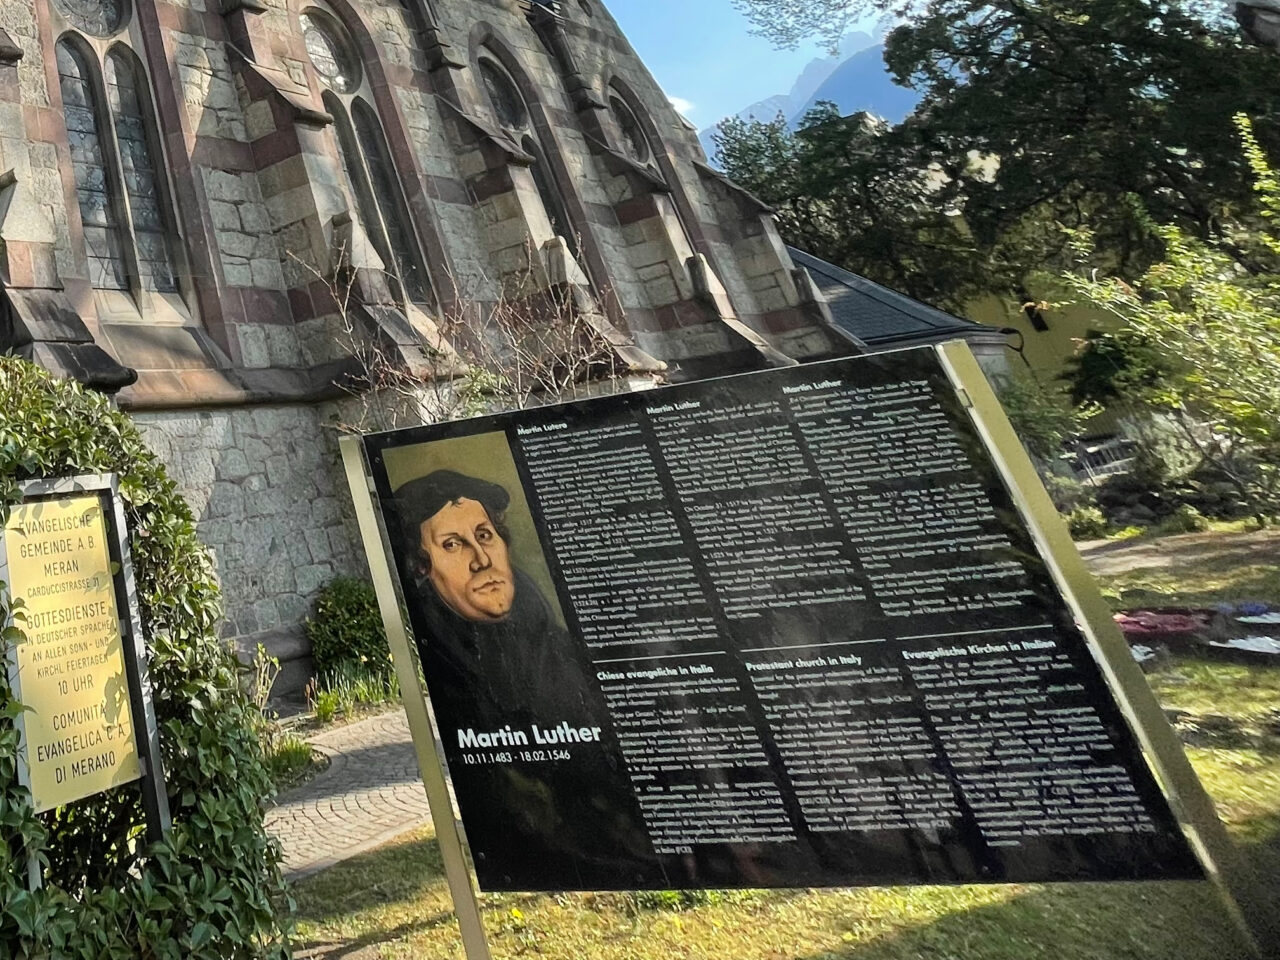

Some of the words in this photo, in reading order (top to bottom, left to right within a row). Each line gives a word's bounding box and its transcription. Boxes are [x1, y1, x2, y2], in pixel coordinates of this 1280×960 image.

[782, 383, 813, 394] Martin
[812, 380, 842, 390] Luther
[646, 404, 674, 415] Martin
[673, 401, 700, 411] Luther
[517, 426, 543, 436] Martin
[20, 538, 73, 559] GEMEINDE
[44, 559, 79, 577] MERAN
[27, 577, 90, 599] CARDUCCISTRASSE
[26, 600, 107, 630] GOTTESDIENSTE
[36, 626, 78, 645] DEUTSCHER
[80, 619, 111, 636] SPRACHE
[32, 651, 42, 663] AN
[45, 645, 67, 660] ALLEN
[95, 636, 110, 649] UND
[901, 646, 968, 660] Evangelische
[967, 643, 1009, 655] Kirchen
[1008, 641, 1021, 652] in
[1021, 639, 1057, 651] Italien
[66, 652, 109, 672] FEIERTAGEN
[596, 671, 625, 681] Chiese
[626, 666, 678, 680] evangeliche
[678, 665, 689, 675] in
[689, 664, 715, 675] Italia
[745, 660, 794, 671] Protestant
[795, 657, 827, 668] church
[827, 656, 839, 665] in
[838, 653, 862, 666] Italy
[58, 679, 69, 696] 10
[72, 673, 94, 692] UHR
[457, 724, 529, 749] Martin
[531, 720, 602, 745] Luther
[37, 729, 103, 763] EVANGELICA
[55, 765, 67, 784] DI
[71, 750, 116, 778] MERANO
[462, 751, 513, 765] 10.11.1483
[519, 749, 571, 762] 18.02.1546
